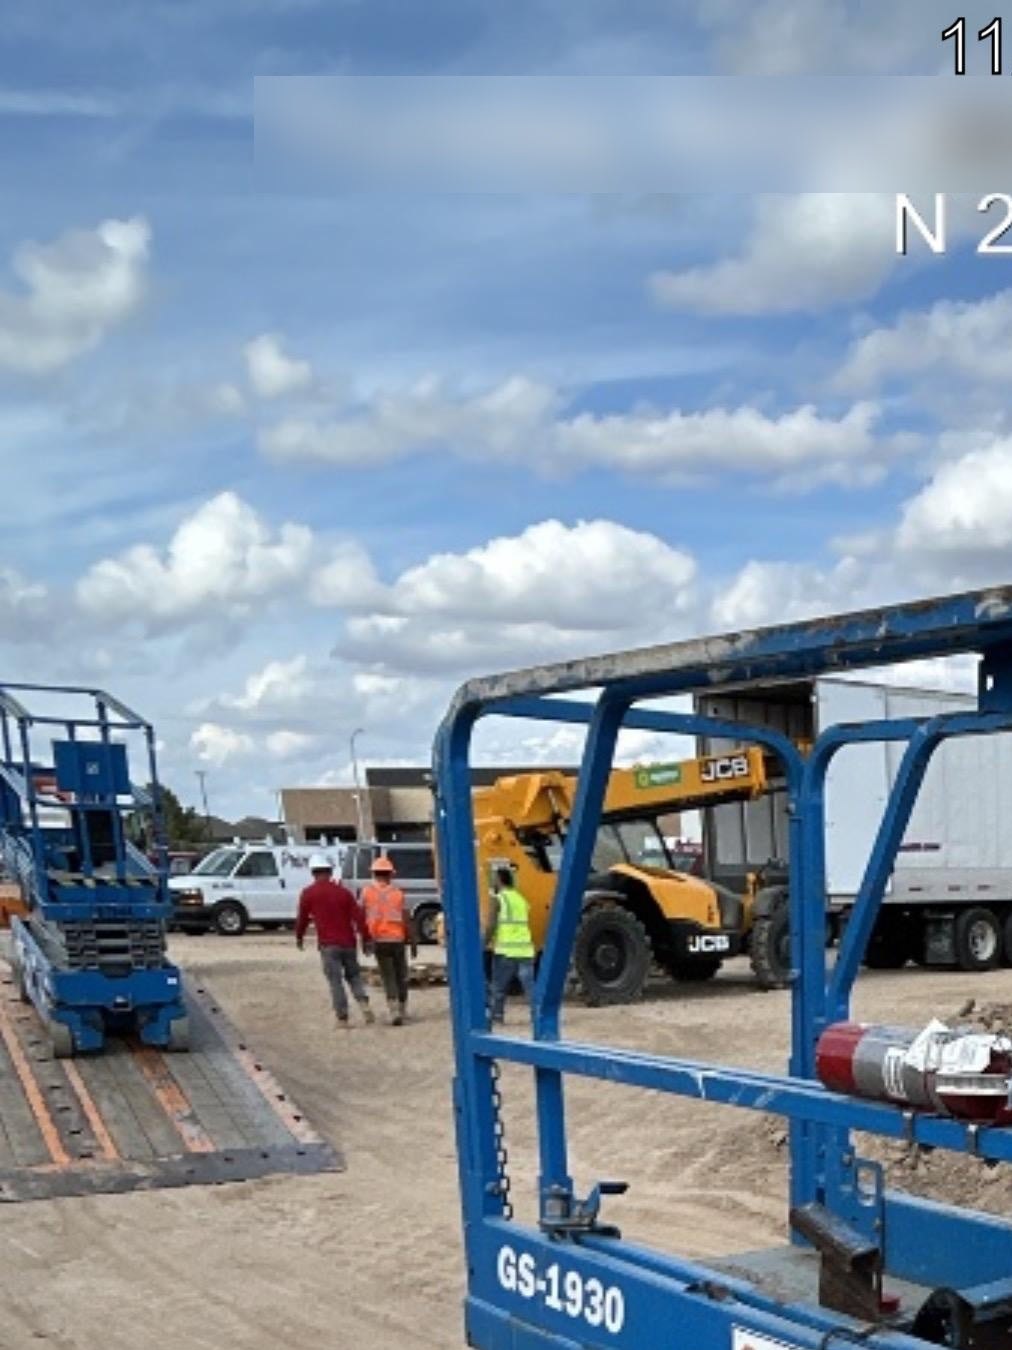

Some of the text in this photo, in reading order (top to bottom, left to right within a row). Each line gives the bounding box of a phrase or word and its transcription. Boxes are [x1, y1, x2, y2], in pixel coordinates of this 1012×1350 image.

[701, 756, 748, 781] JCB
[688, 935, 730, 953] JCB
[497, 1244, 625, 1334] GS-1930
